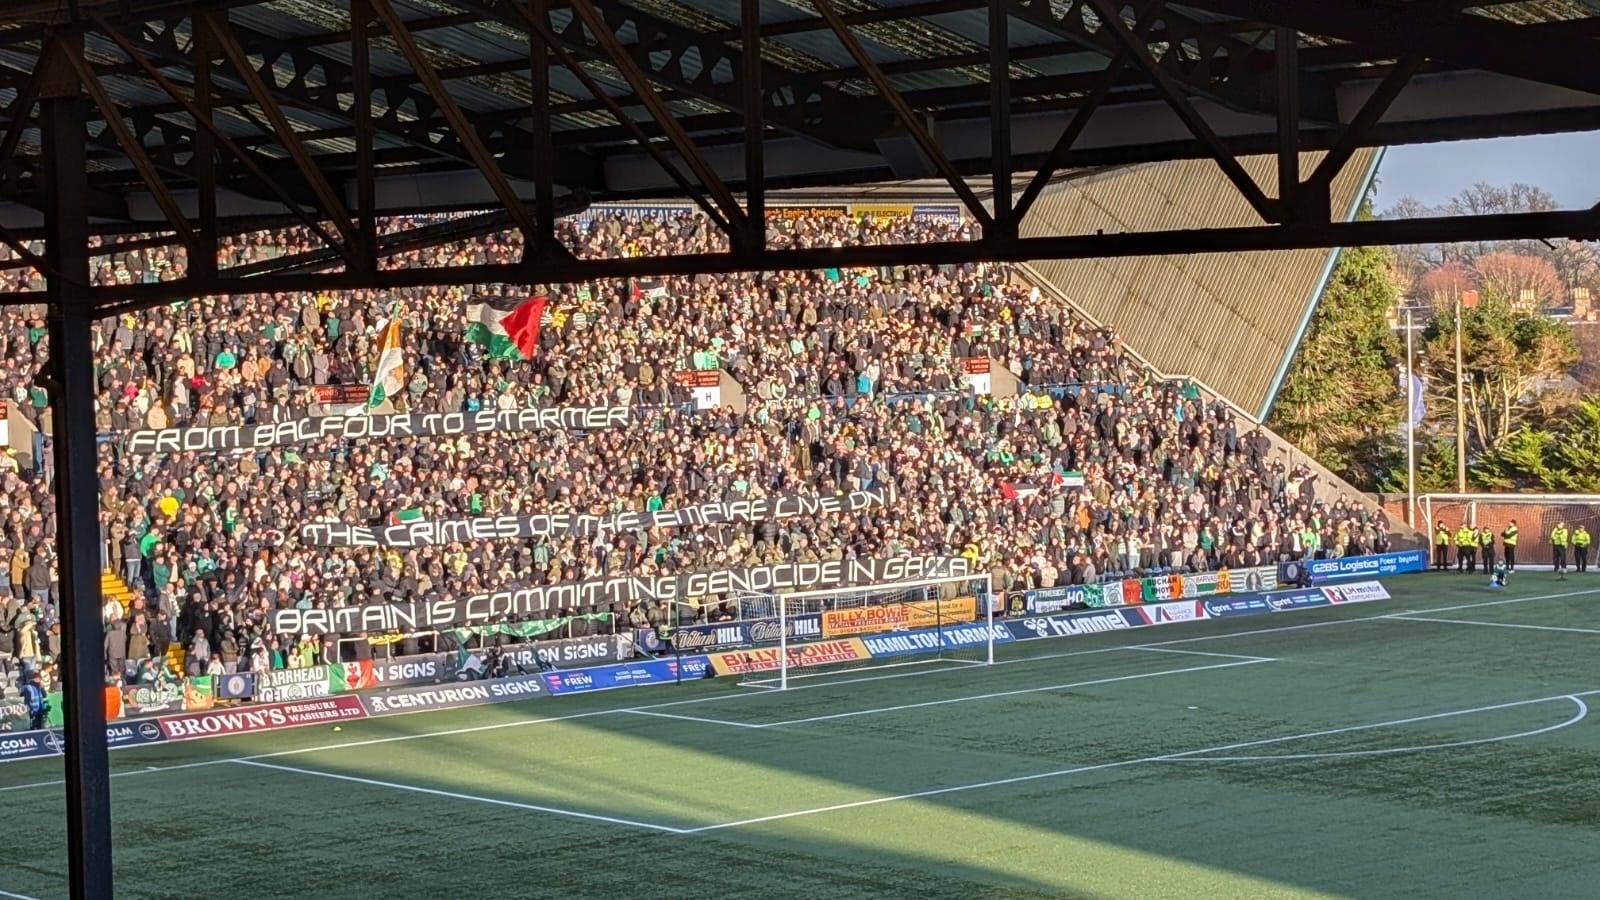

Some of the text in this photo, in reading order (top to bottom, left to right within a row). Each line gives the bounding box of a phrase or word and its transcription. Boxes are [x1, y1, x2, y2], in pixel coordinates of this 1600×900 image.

[705, 392, 711, 401] H
[131, 407, 629, 452] FROM BALFOUR TO STARMER
[303, 487, 885, 546] THE CRIMES OF THE EMPIRE LIVE ON
[1340, 559, 1378, 572] Logistics
[1398, 555, 1419, 564] beyond
[1147, 576, 1178, 586] BUCHAN
[276, 555, 968, 634] BRITAIN IS COMMITTING GENOCIDE IN GAZA
[827, 611, 864, 625] BILLY
[866, 605, 910, 619] BOWIE
[1047, 608, 1131, 635] hummel
[794, 618, 821, 635] HILL
[672, 626, 744, 650] William HILL
[864, 623, 1010, 655] HAMILTON TARMAC
[564, 642, 608, 660] SIGNS
[721, 647, 782, 667] BILLY
[388, 661, 436, 681] SIGNS
[564, 675, 592, 687] FREW
[389, 679, 542, 708] CENTURION SIGNS
[284, 701, 338, 714] PRESSURE
[287, 706, 361, 722] WASHERS LTD
[167, 708, 285, 737] BROWN'S
